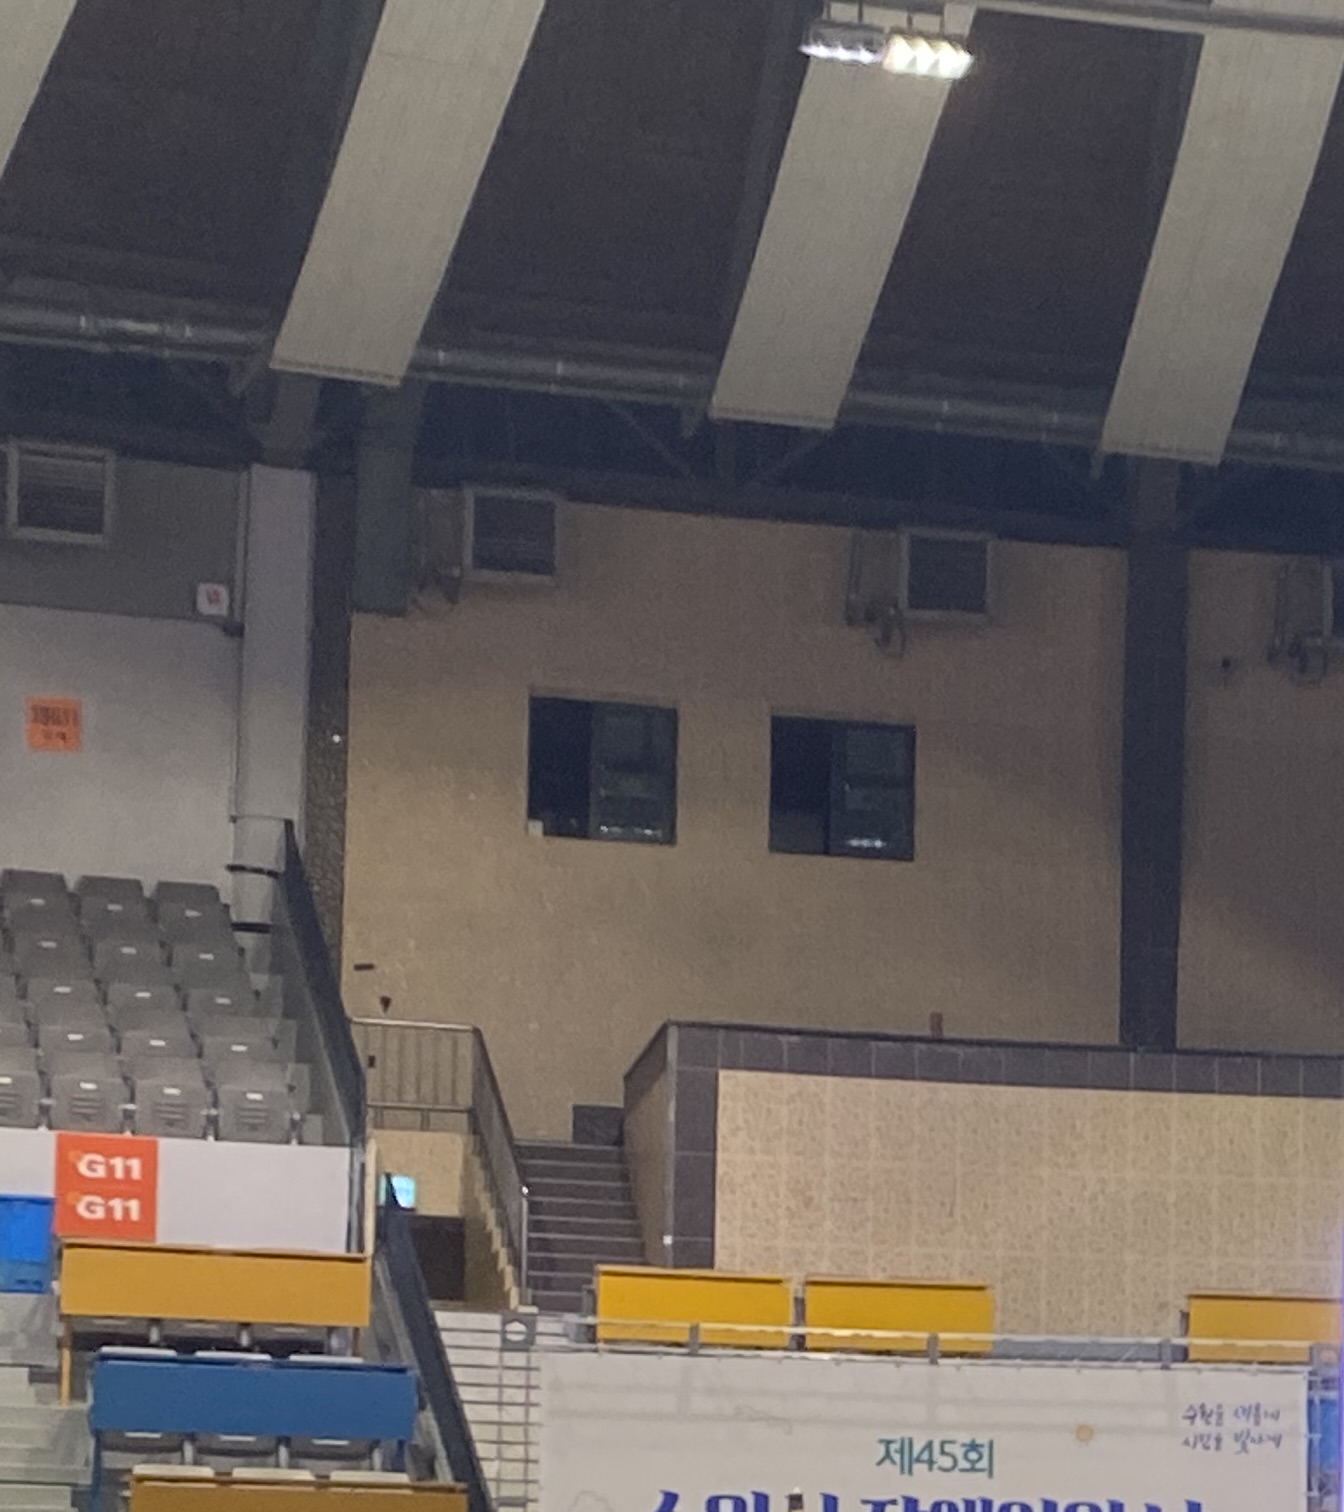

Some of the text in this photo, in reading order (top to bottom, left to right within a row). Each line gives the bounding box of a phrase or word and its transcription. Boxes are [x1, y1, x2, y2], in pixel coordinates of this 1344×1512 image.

[76, 1153, 142, 1181] G11
[76, 1194, 141, 1222] G11
[876, 1437, 994, 1478] 제45회
